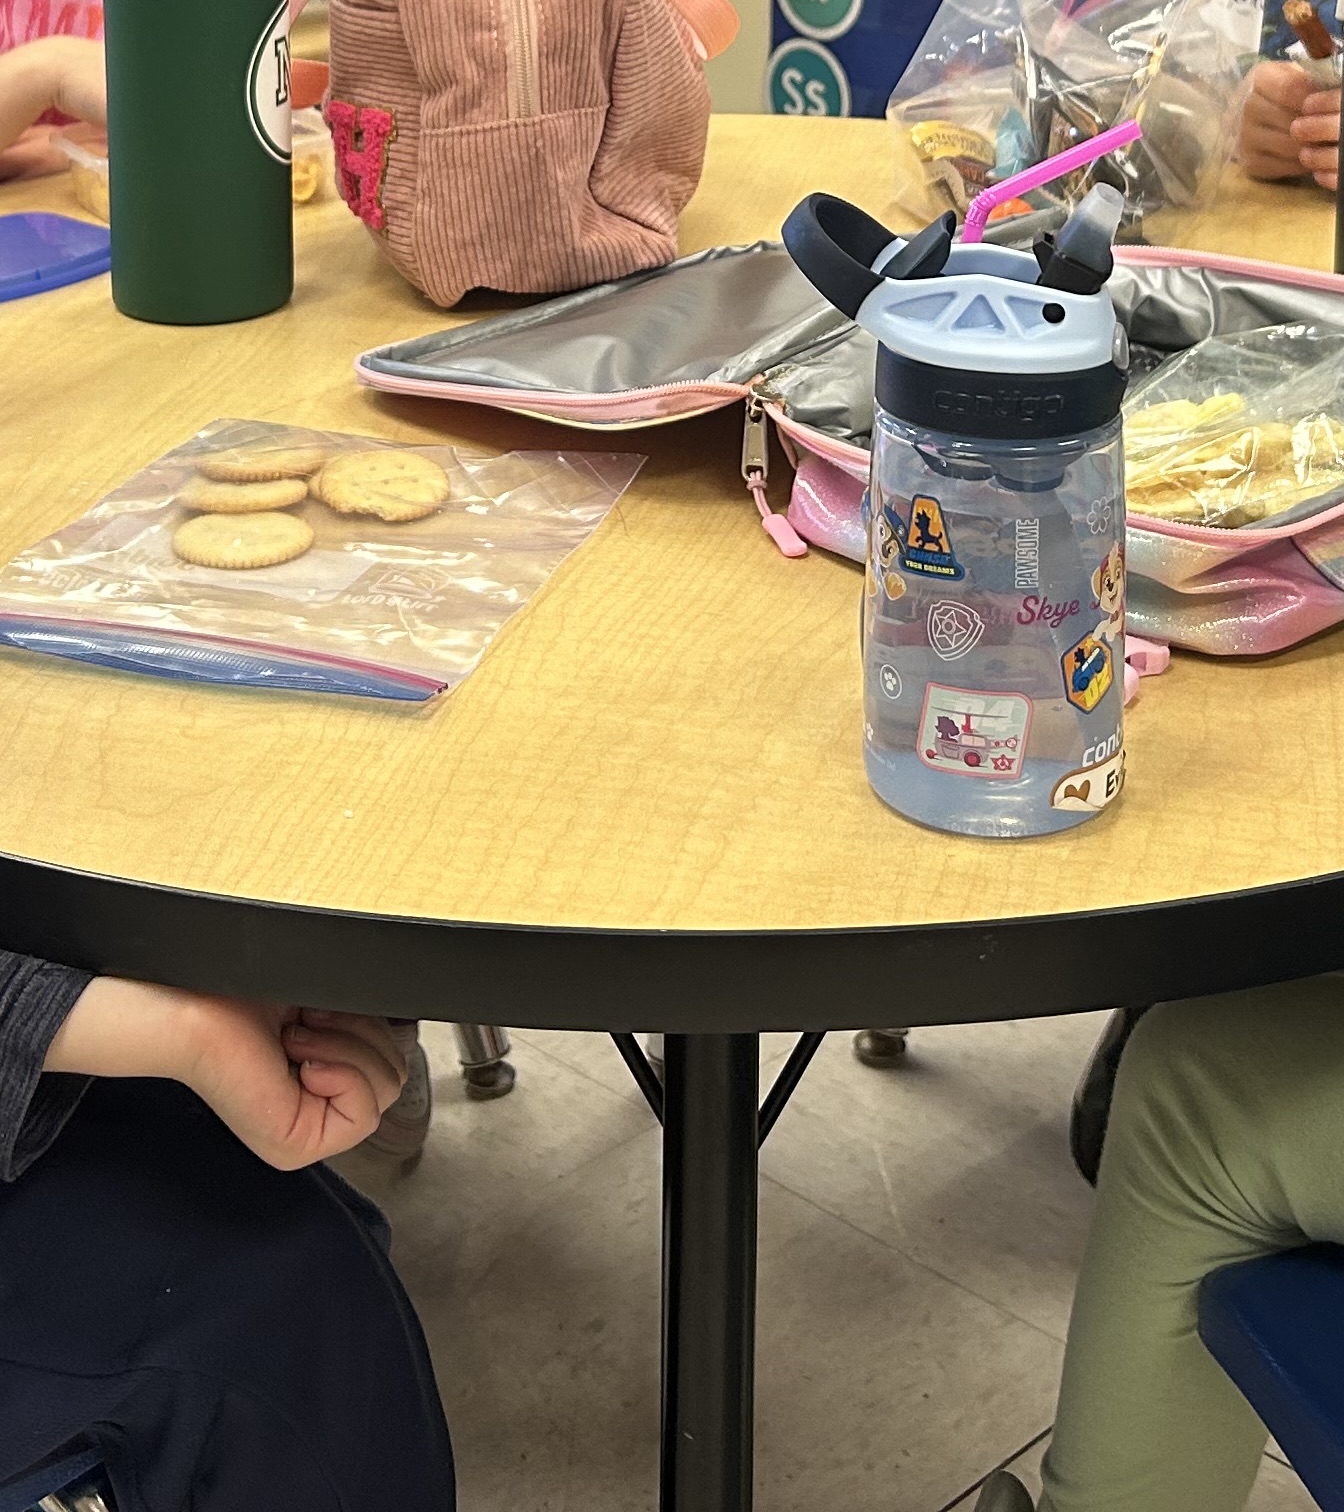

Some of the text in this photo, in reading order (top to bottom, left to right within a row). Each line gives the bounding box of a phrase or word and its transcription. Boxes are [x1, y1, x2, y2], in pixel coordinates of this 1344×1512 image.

[781, 67, 829, 114] Ss
[935, 388, 1065, 423] contigo
[1014, 518, 1040, 589] PAWSOME
[1016, 594, 1081, 629] Skye
